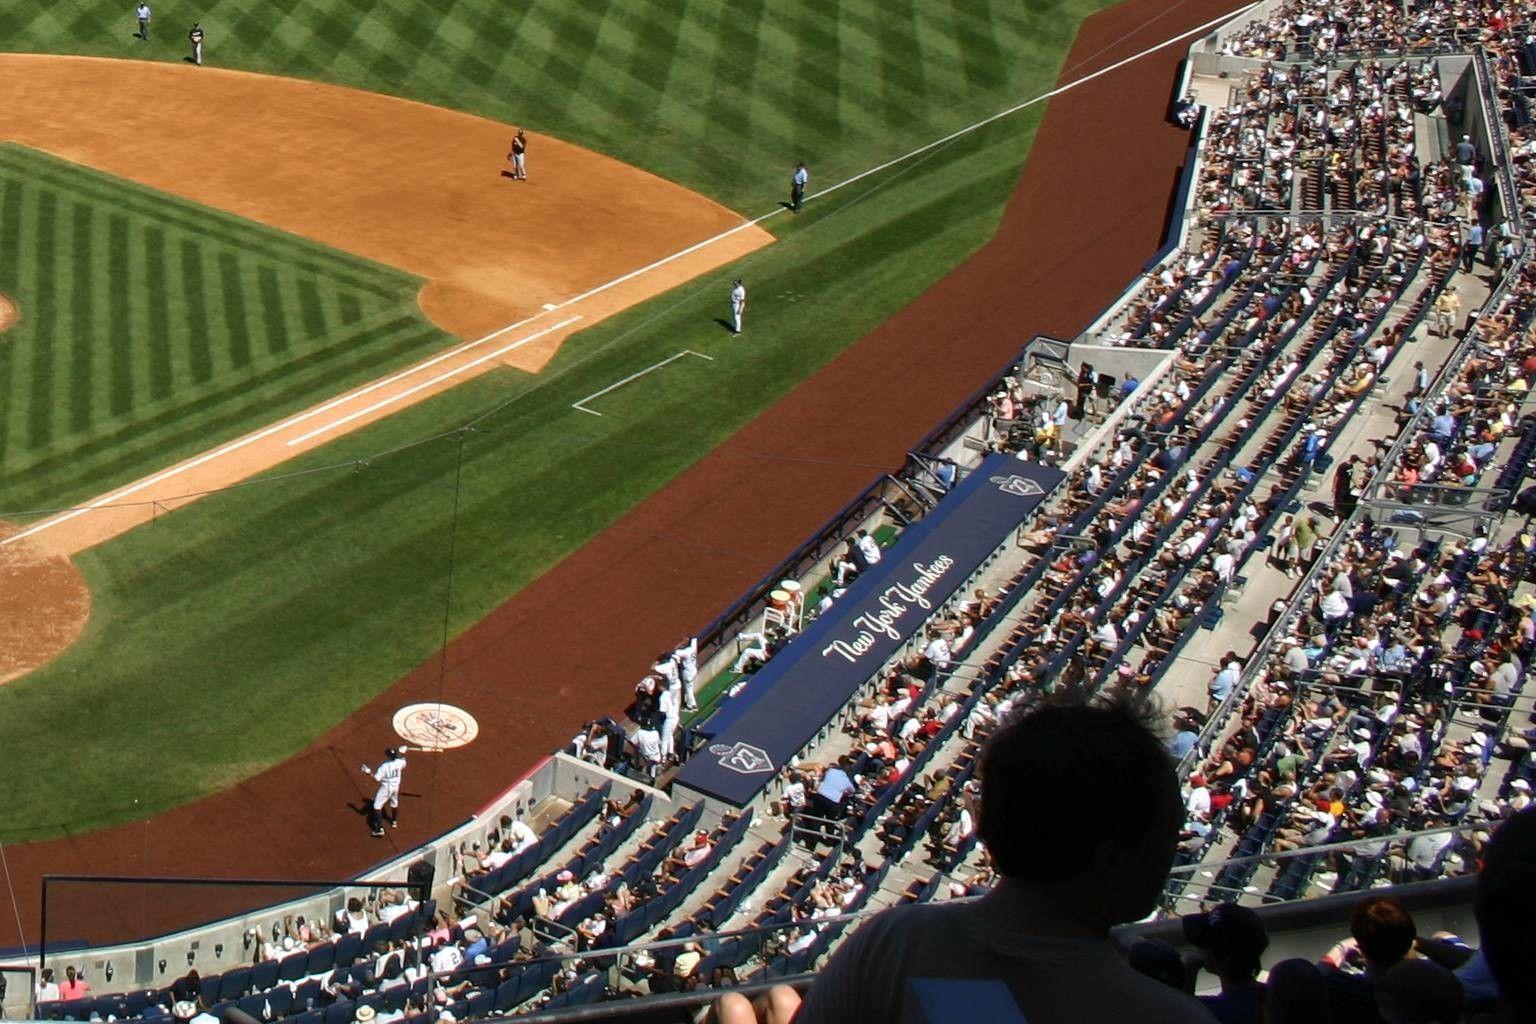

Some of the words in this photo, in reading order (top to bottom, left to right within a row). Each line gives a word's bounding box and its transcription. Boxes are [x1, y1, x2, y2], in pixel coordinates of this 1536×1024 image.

[822, 630, 876, 663] New
[853, 595, 908, 640] York
[884, 554, 955, 610] Yankees
